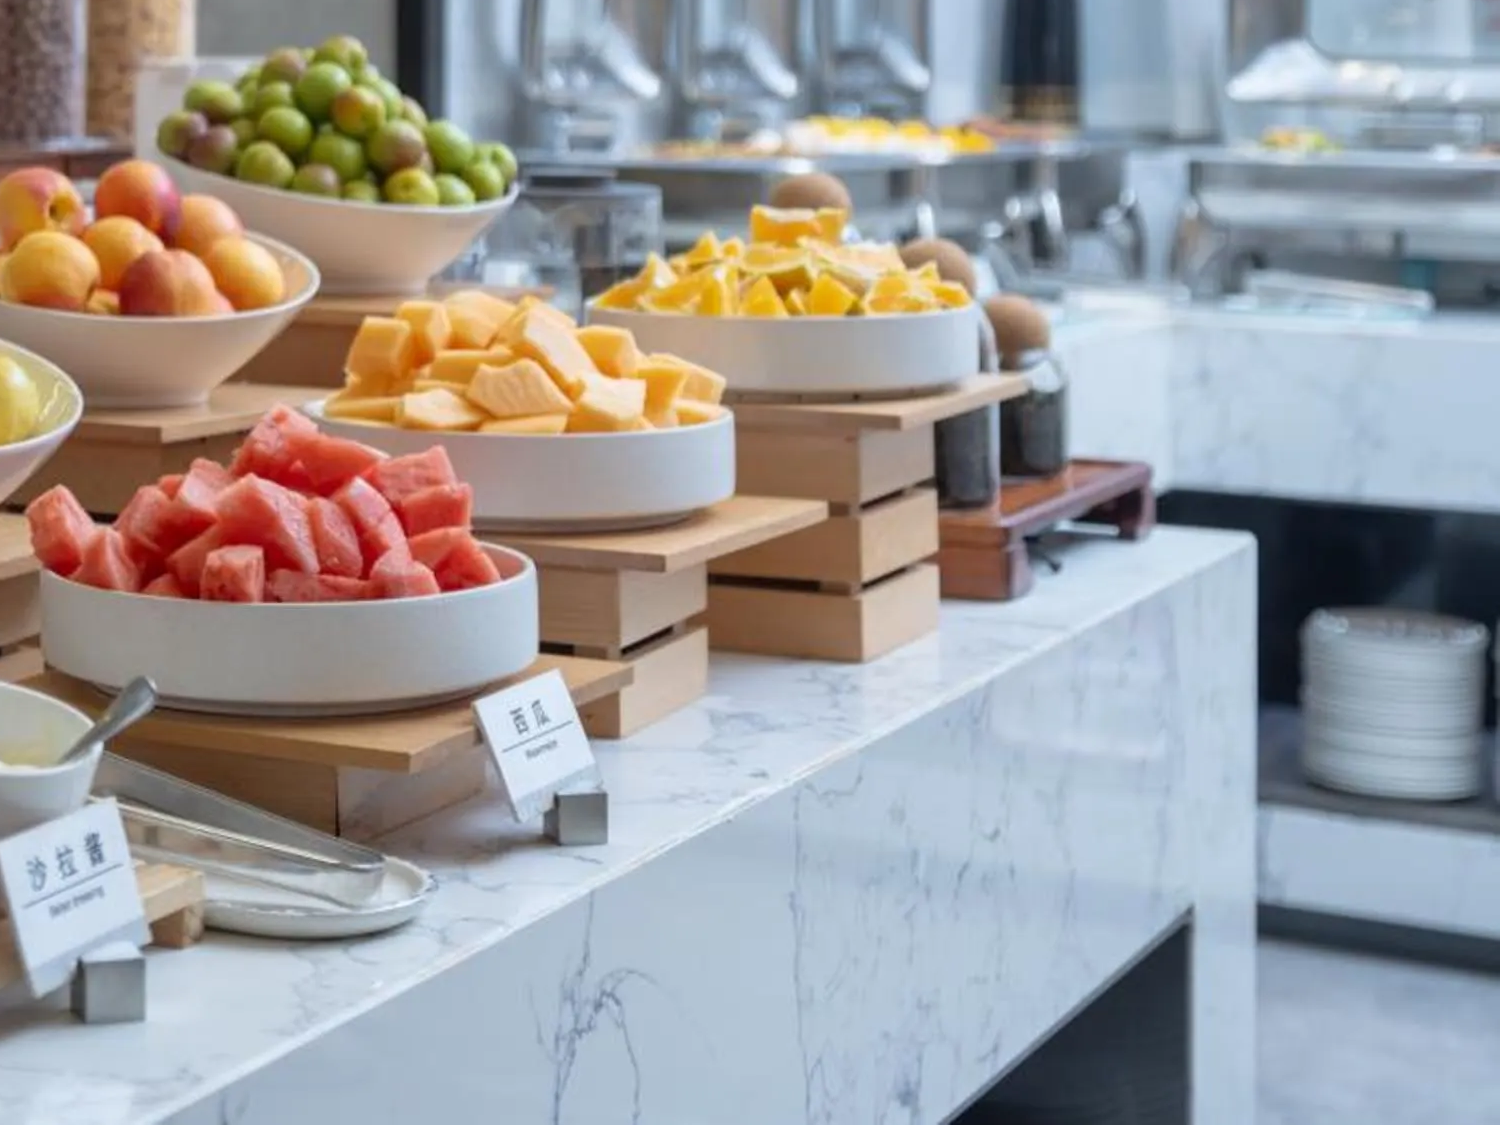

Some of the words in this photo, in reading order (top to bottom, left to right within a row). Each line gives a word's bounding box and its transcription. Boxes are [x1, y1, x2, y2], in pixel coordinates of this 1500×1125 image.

[509, 698, 550, 735] 西瓜
[25, 829, 105, 893] 沙拉酱
